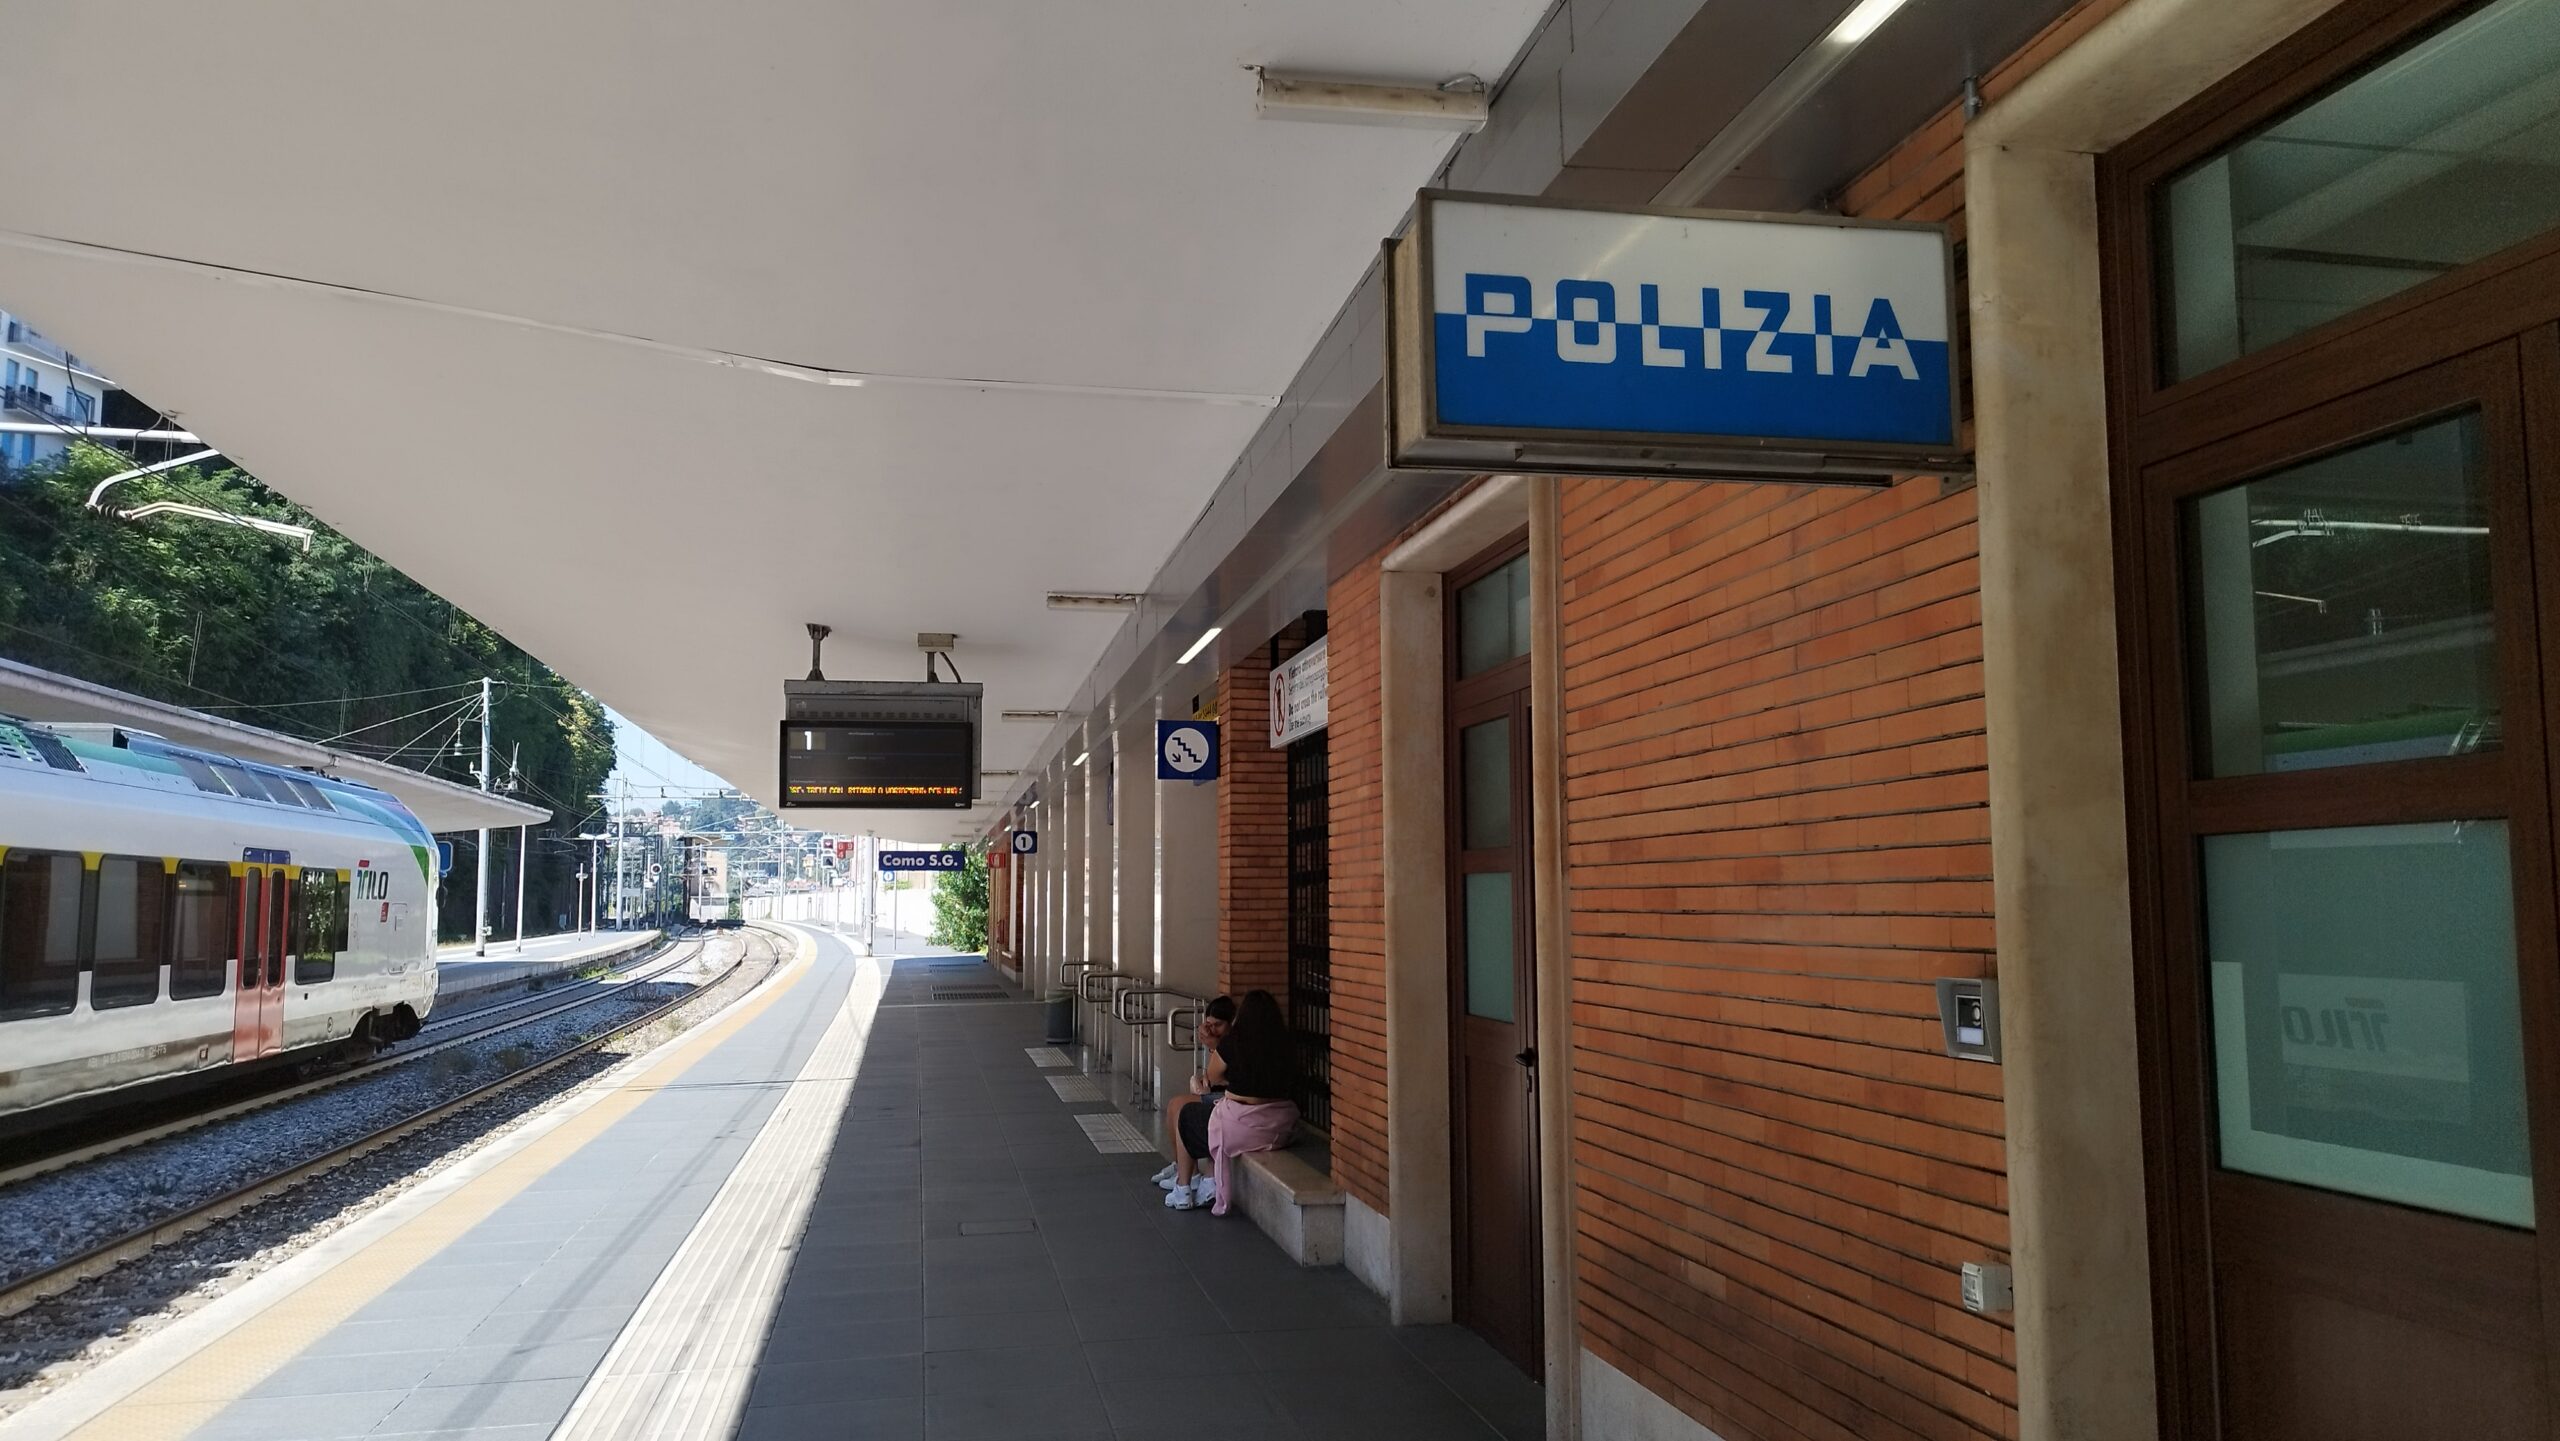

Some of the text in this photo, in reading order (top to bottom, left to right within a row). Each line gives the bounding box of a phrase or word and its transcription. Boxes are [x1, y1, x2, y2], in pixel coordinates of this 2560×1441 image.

[1465, 272, 1921, 381] POLIZIA
[804, 731, 812, 750] 1
[1021, 837, 1026, 848] 1
[882, 854, 958, 867] Como S.G.
[357, 869, 389, 900] TILO
